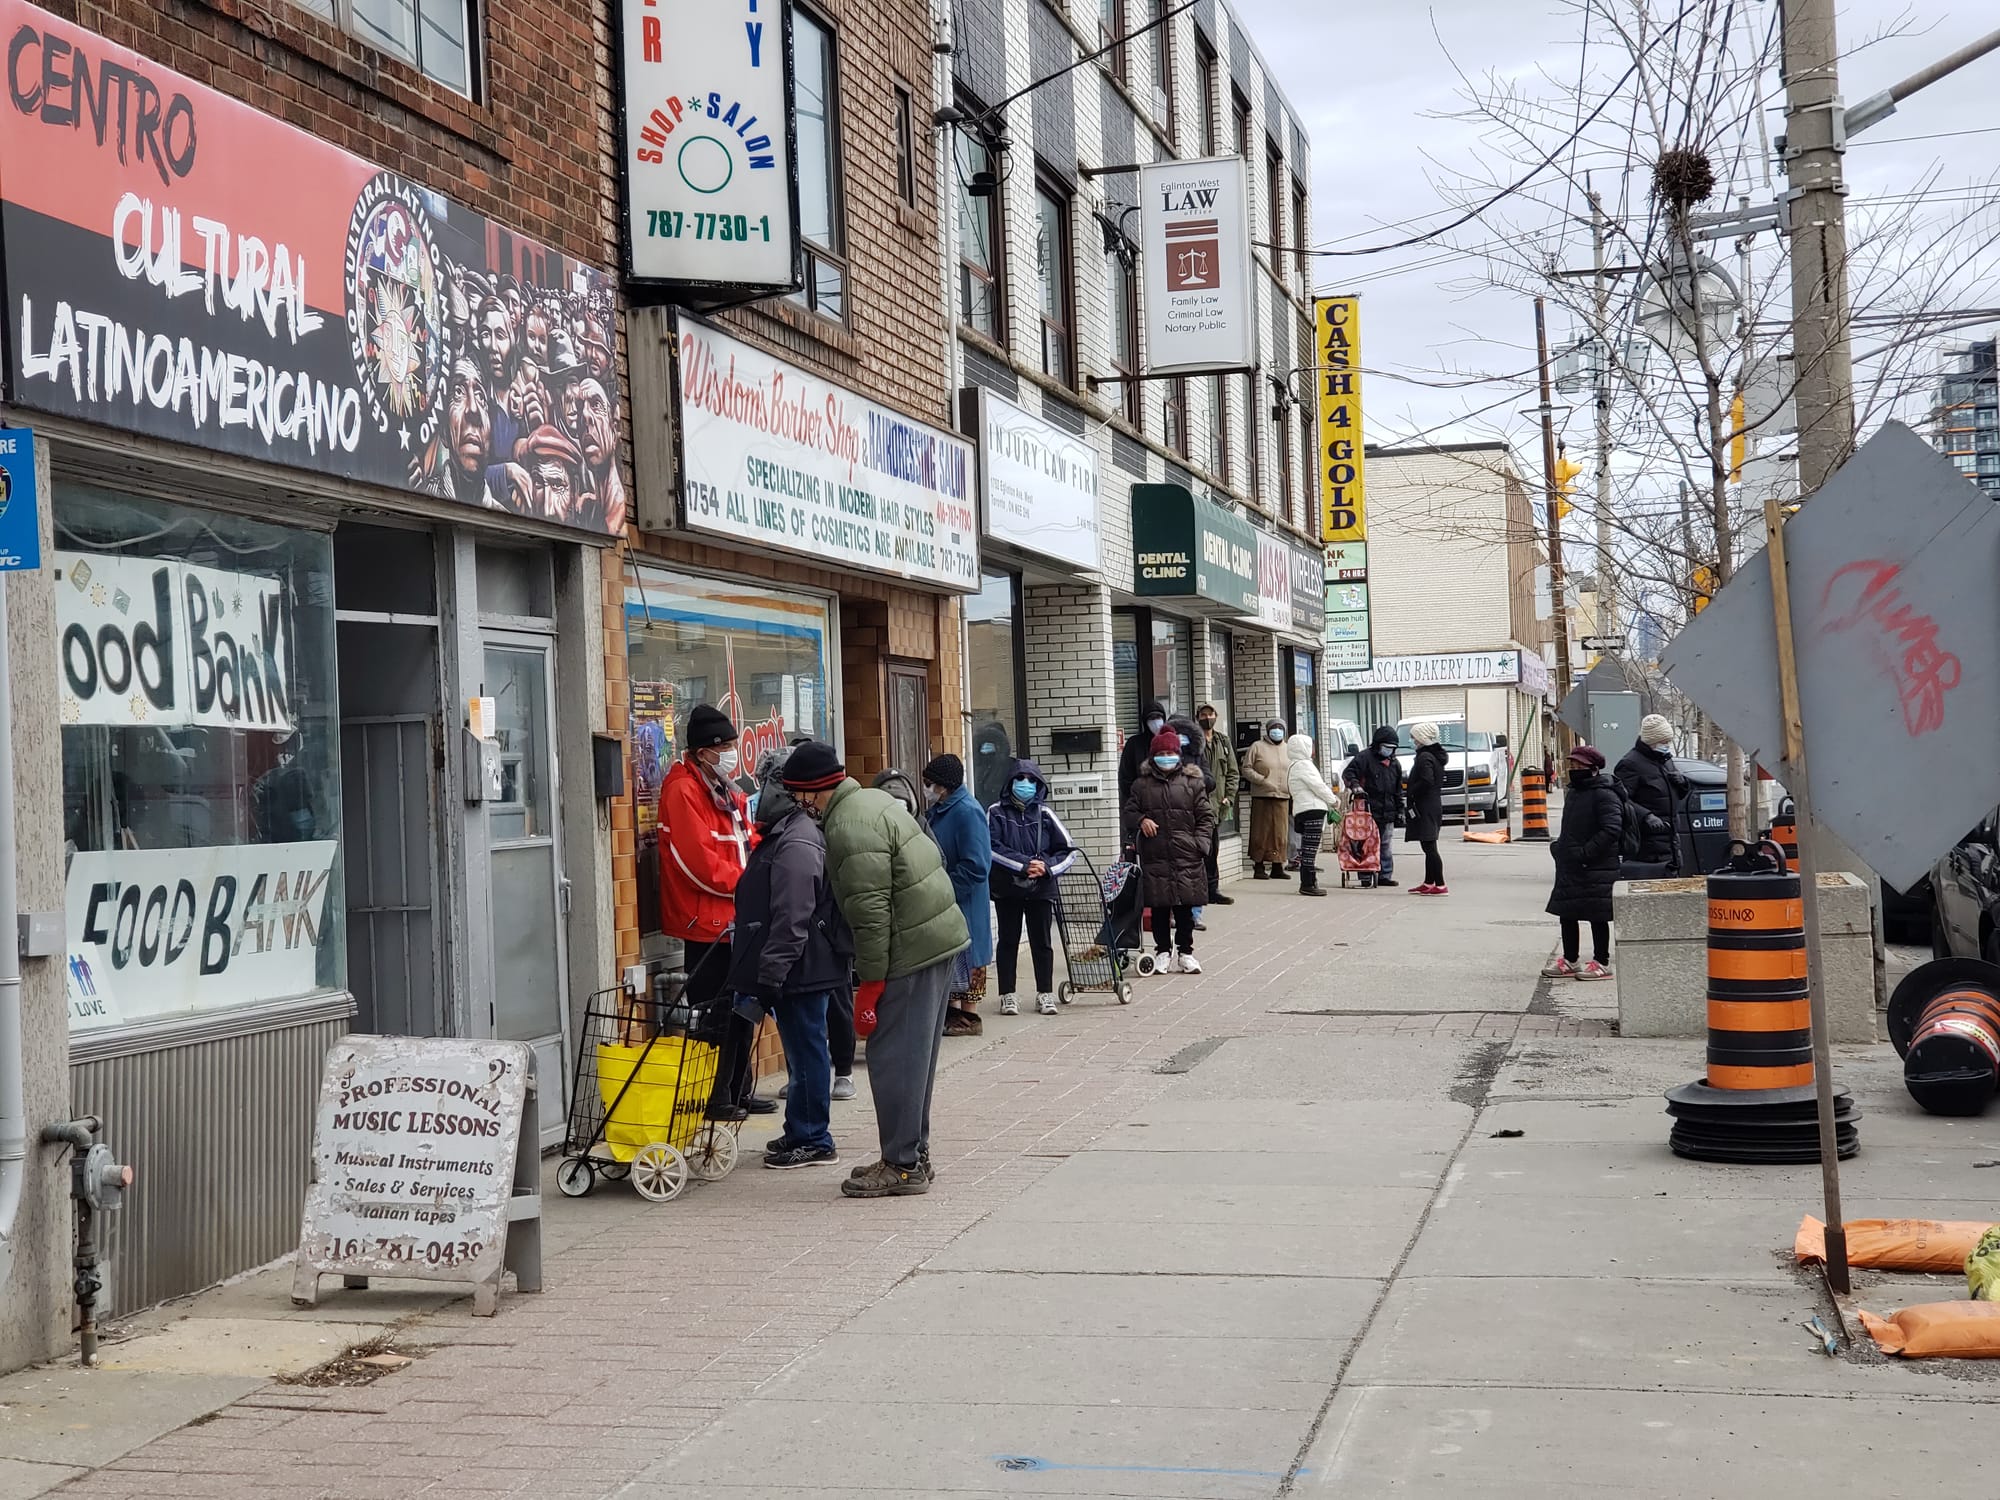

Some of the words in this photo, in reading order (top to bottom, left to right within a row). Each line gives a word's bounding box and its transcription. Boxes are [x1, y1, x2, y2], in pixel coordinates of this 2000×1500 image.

[8, 25, 197, 187] CENTRO
[637, 96, 684, 165] SHOP
[706, 92, 775, 169] SALON
[1160, 182, 1196, 192] Eglinton
[1198, 179, 1220, 188] West
[1161, 188, 1220, 212] LAW
[345, 172, 392, 295] CULTURAL
[647, 210, 770, 242] 787-7730-1
[113, 192, 324, 345] CULTURAL
[394, 175, 452, 444] LATINOAMERICANO
[1167, 309, 1203, 320] Criminal
[1205, 307, 1224, 318] Law
[1171, 296, 1198, 307] Family
[1200, 295, 1219, 304] Law
[1164, 323, 1196, 334] Notary
[1199, 320, 1227, 331] Public
[1325, 303, 1354, 396] CASH
[21, 293, 361, 457] LATINOAMERICANO
[346, 308, 388, 434] CENTRO
[681, 332, 768, 433] Wisdom's
[769, 368, 823, 451] Barber
[825, 393, 859, 485] Shop
[862, 437, 869, 467] &
[868, 410, 937, 491] HAIRDRESSING
[938, 439, 967, 502] SALON
[1328, 405, 1352, 428] 4
[989, 423, 1038, 471] INJURY
[1044, 450, 1067, 484] LAW
[1072, 463, 1098, 498] FIRM
[747, 455, 820, 505] SPECIALIZING
[824, 479, 835, 508] IN
[838, 484, 877, 521] MODERN
[880, 497, 901, 528] HAIR
[904, 504, 935, 538] STYLES
[1328, 440, 1357, 530] GOLD
[686, 479, 720, 518] 1754
[726, 490, 749, 524] ALL
[753, 496, 786, 534] LINES
[791, 506, 806, 537] OF
[812, 512, 871, 555] COSMETICS
[875, 529, 892, 559] ARE
[894, 536, 936, 569] AVAILABLE
[940, 547, 974, 578] 787-7731
[1138, 552, 1190, 565] DENTAL
[1203, 529, 1231, 571] DENTAL
[1231, 543, 1253, 581] CLINIC
[1142, 566, 1187, 579] CLINIC
[1274, 547, 1290, 605] SPA
[1290, 549, 1324, 599] WIRELESS
[1342, 570, 1351, 578] 24
[1352, 569, 1366, 577] HRS
[1350, 614, 1365, 622] hub
[1414, 657, 1464, 682] BAKERY
[1467, 656, 1495, 680] LTD.
[1703, 816, 1725, 828] Litter
[82, 879, 196, 971] FOOD
[200, 868, 331, 976] BANK
[74, 1000, 106, 1017] LOVE
[338, 1076, 502, 1118] PROFESSIONAL
[332, 1111, 402, 1133] MUSIC
[406, 1111, 502, 1138] LESSONS
[399, 1154, 493, 1176] Instruments
[344, 1177, 386, 1194] Sales
[390, 1180, 405, 1194] &
[410, 1181, 475, 1199] Services
[414, 1207, 456, 1226] tapes
